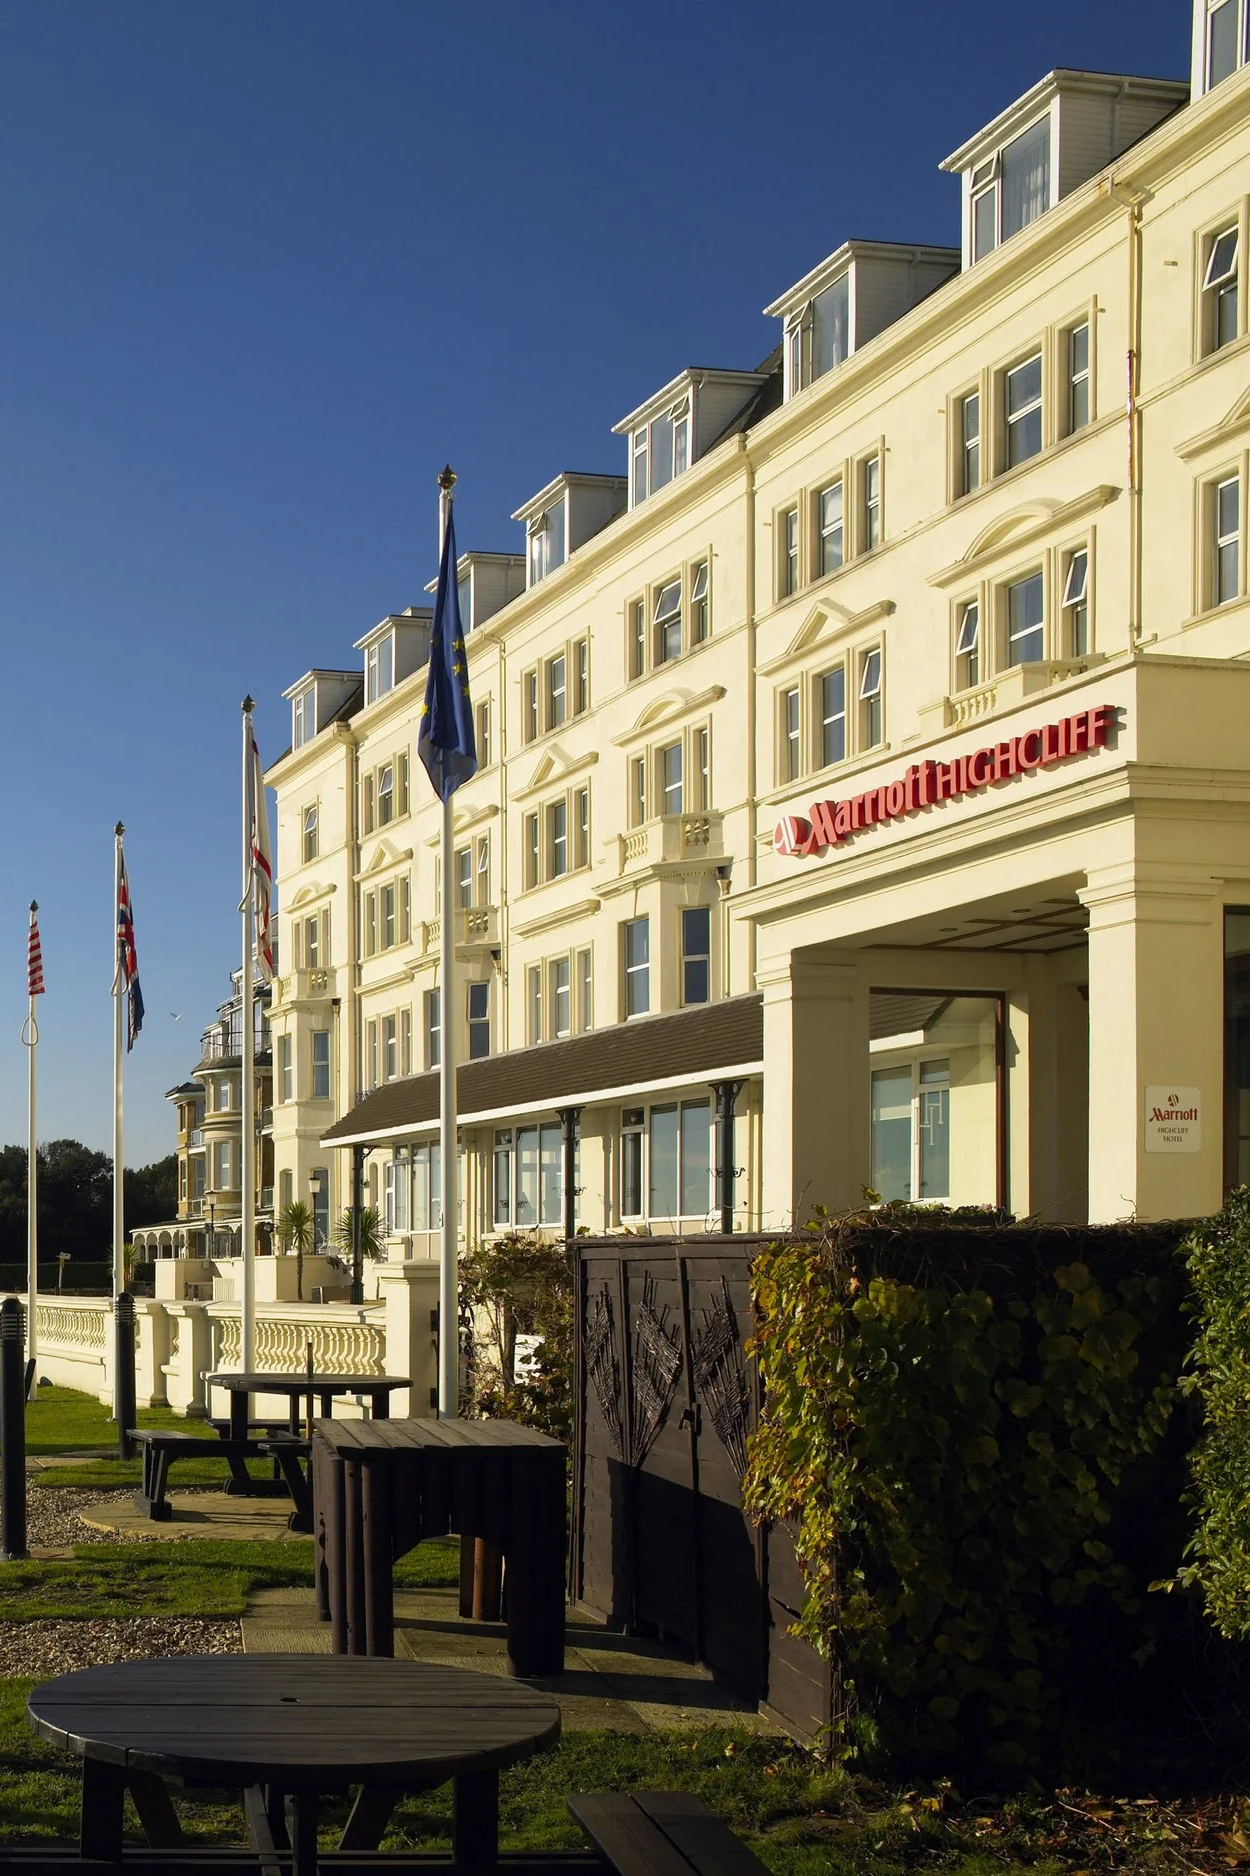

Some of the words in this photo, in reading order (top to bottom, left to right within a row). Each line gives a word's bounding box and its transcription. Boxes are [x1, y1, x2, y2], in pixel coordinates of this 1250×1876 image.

[802, 760, 937, 855] Marriott
[936, 704, 1116, 800] HIGHCLIFF
[1148, 1107, 1198, 1122] Marriott
[1163, 1135, 1183, 1143] HOTEL
